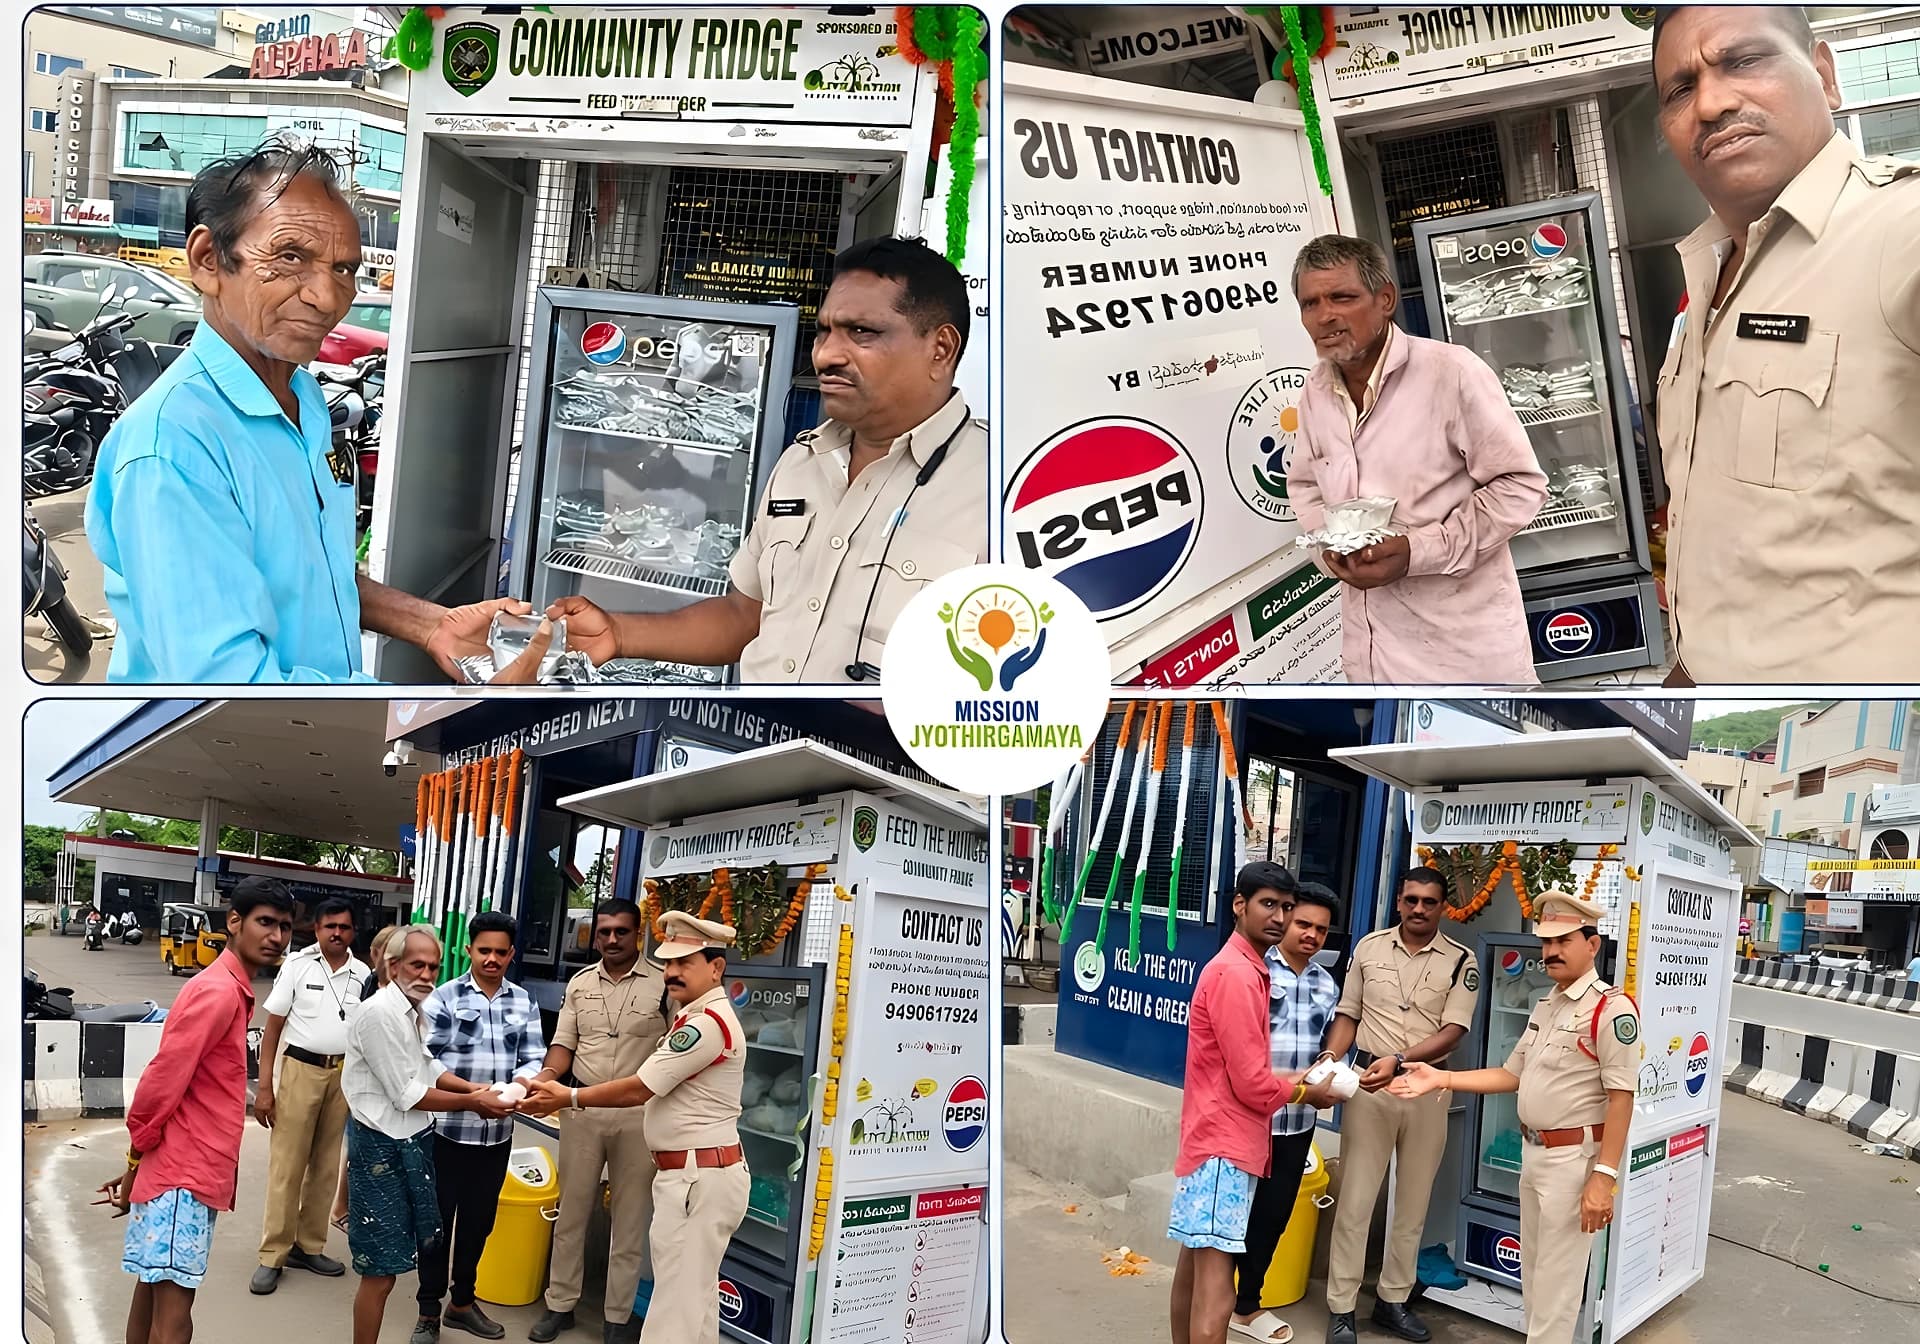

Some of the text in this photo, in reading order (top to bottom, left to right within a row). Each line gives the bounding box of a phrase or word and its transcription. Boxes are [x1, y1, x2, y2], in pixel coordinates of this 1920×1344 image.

[249, 28, 367, 79] ALPHAA
[509, 17, 802, 81] COMMUNITY FRIDGE
[588, 94, 617, 108] FEED
[531, 710, 581, 746] SPEED
[696, 700, 733, 733] NOT
[735, 710, 764, 743] USE
[1532, 800, 1583, 824] FRIDGE
[746, 821, 797, 848] FRIDGE
[886, 815, 917, 847] FEED
[923, 824, 945, 854] THE
[901, 908, 982, 947] CONTACT US
[1144, 953, 1166, 979] THE
[1168, 957, 1196, 985] CITY
[885, 1003, 978, 1024] 9490617924
[1108, 985, 1142, 1015] CLEAN
[945, 1105, 985, 1123] PEPSI
